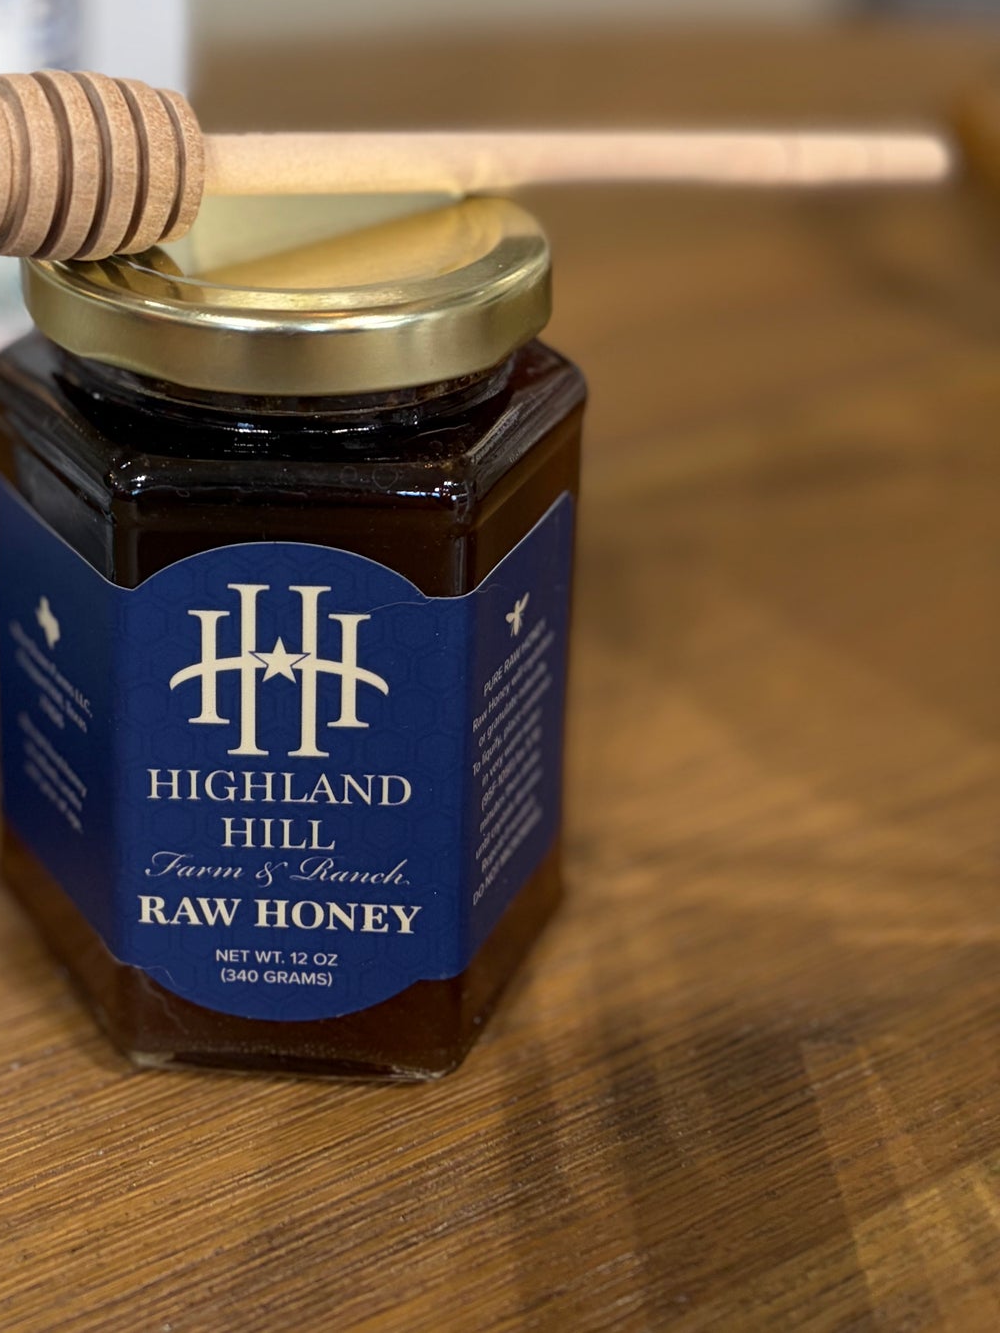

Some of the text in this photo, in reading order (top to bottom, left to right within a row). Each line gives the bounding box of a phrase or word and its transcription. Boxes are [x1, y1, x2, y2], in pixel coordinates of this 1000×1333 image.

[484, 665, 503, 697] PURE
[473, 761, 481, 776] To
[147, 768, 412, 806] HIGHLAND
[221, 817, 336, 850] HILL
[144, 851, 410, 887] Farm & Ranch
[137, 895, 422, 934] RAW HONEY
[215, 949, 338, 966] NET WT. 12 OZ
[220, 968, 333, 987] (340 GRAMS)
